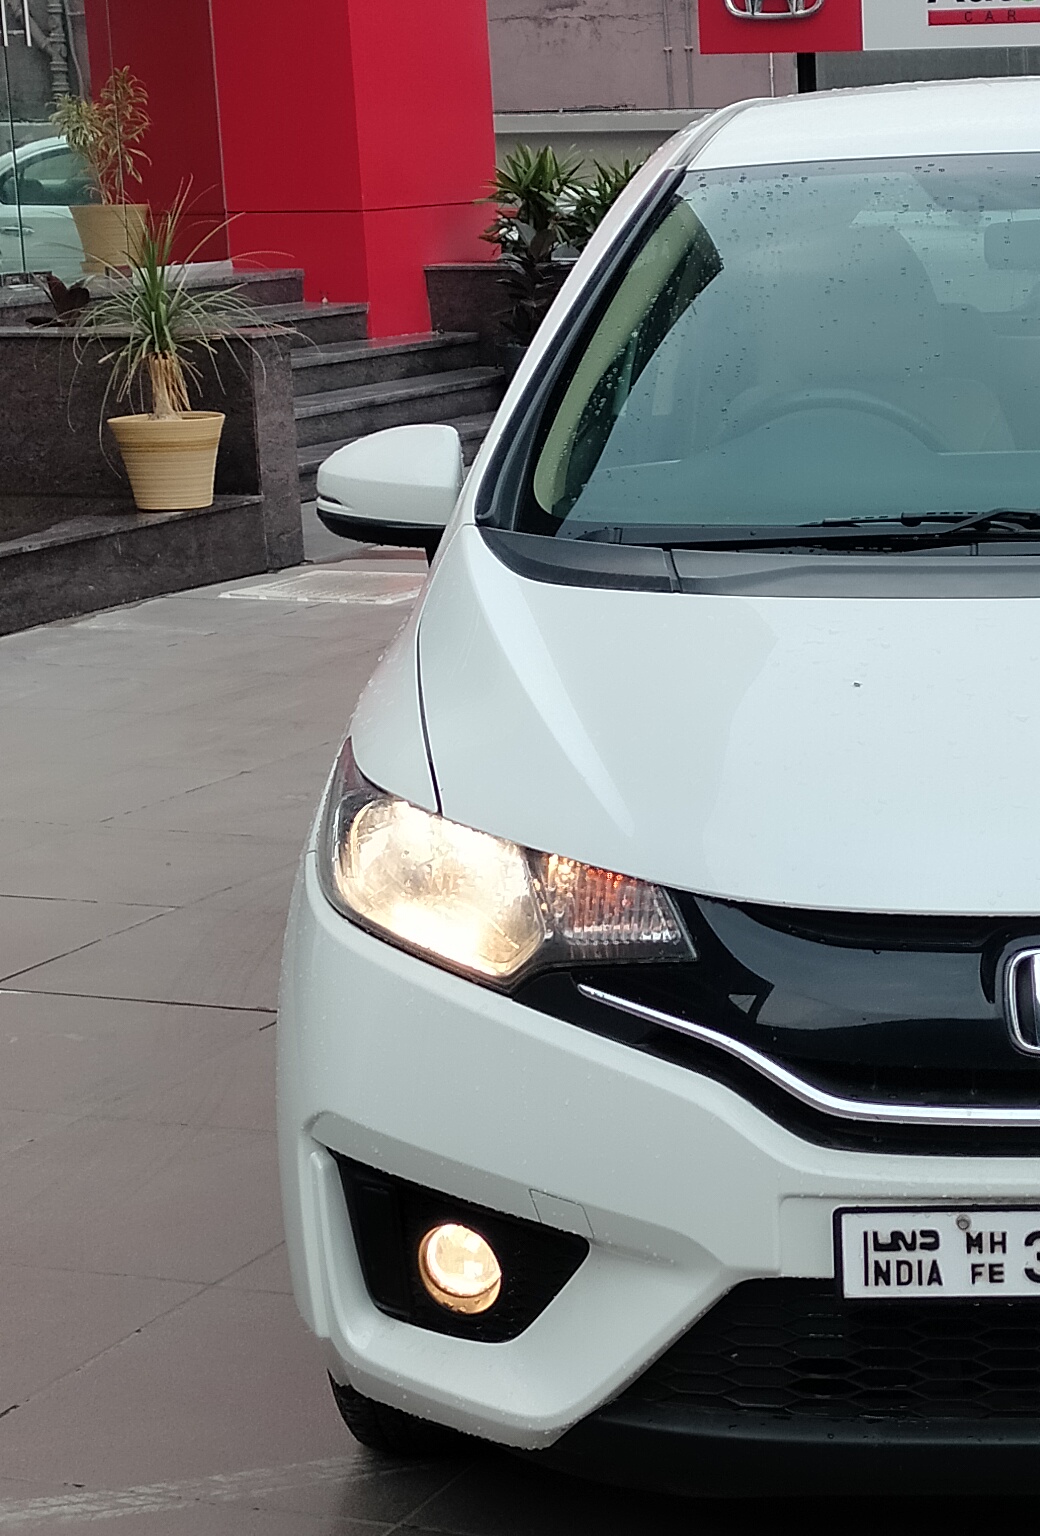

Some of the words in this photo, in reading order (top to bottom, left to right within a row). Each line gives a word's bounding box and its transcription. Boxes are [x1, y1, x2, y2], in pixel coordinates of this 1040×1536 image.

[963, 10, 1018, 23] CAR
[965, 1231, 1007, 1255] MH
[863, 1252, 943, 1287] INDIA
[970, 1262, 1005, 1285] FE
